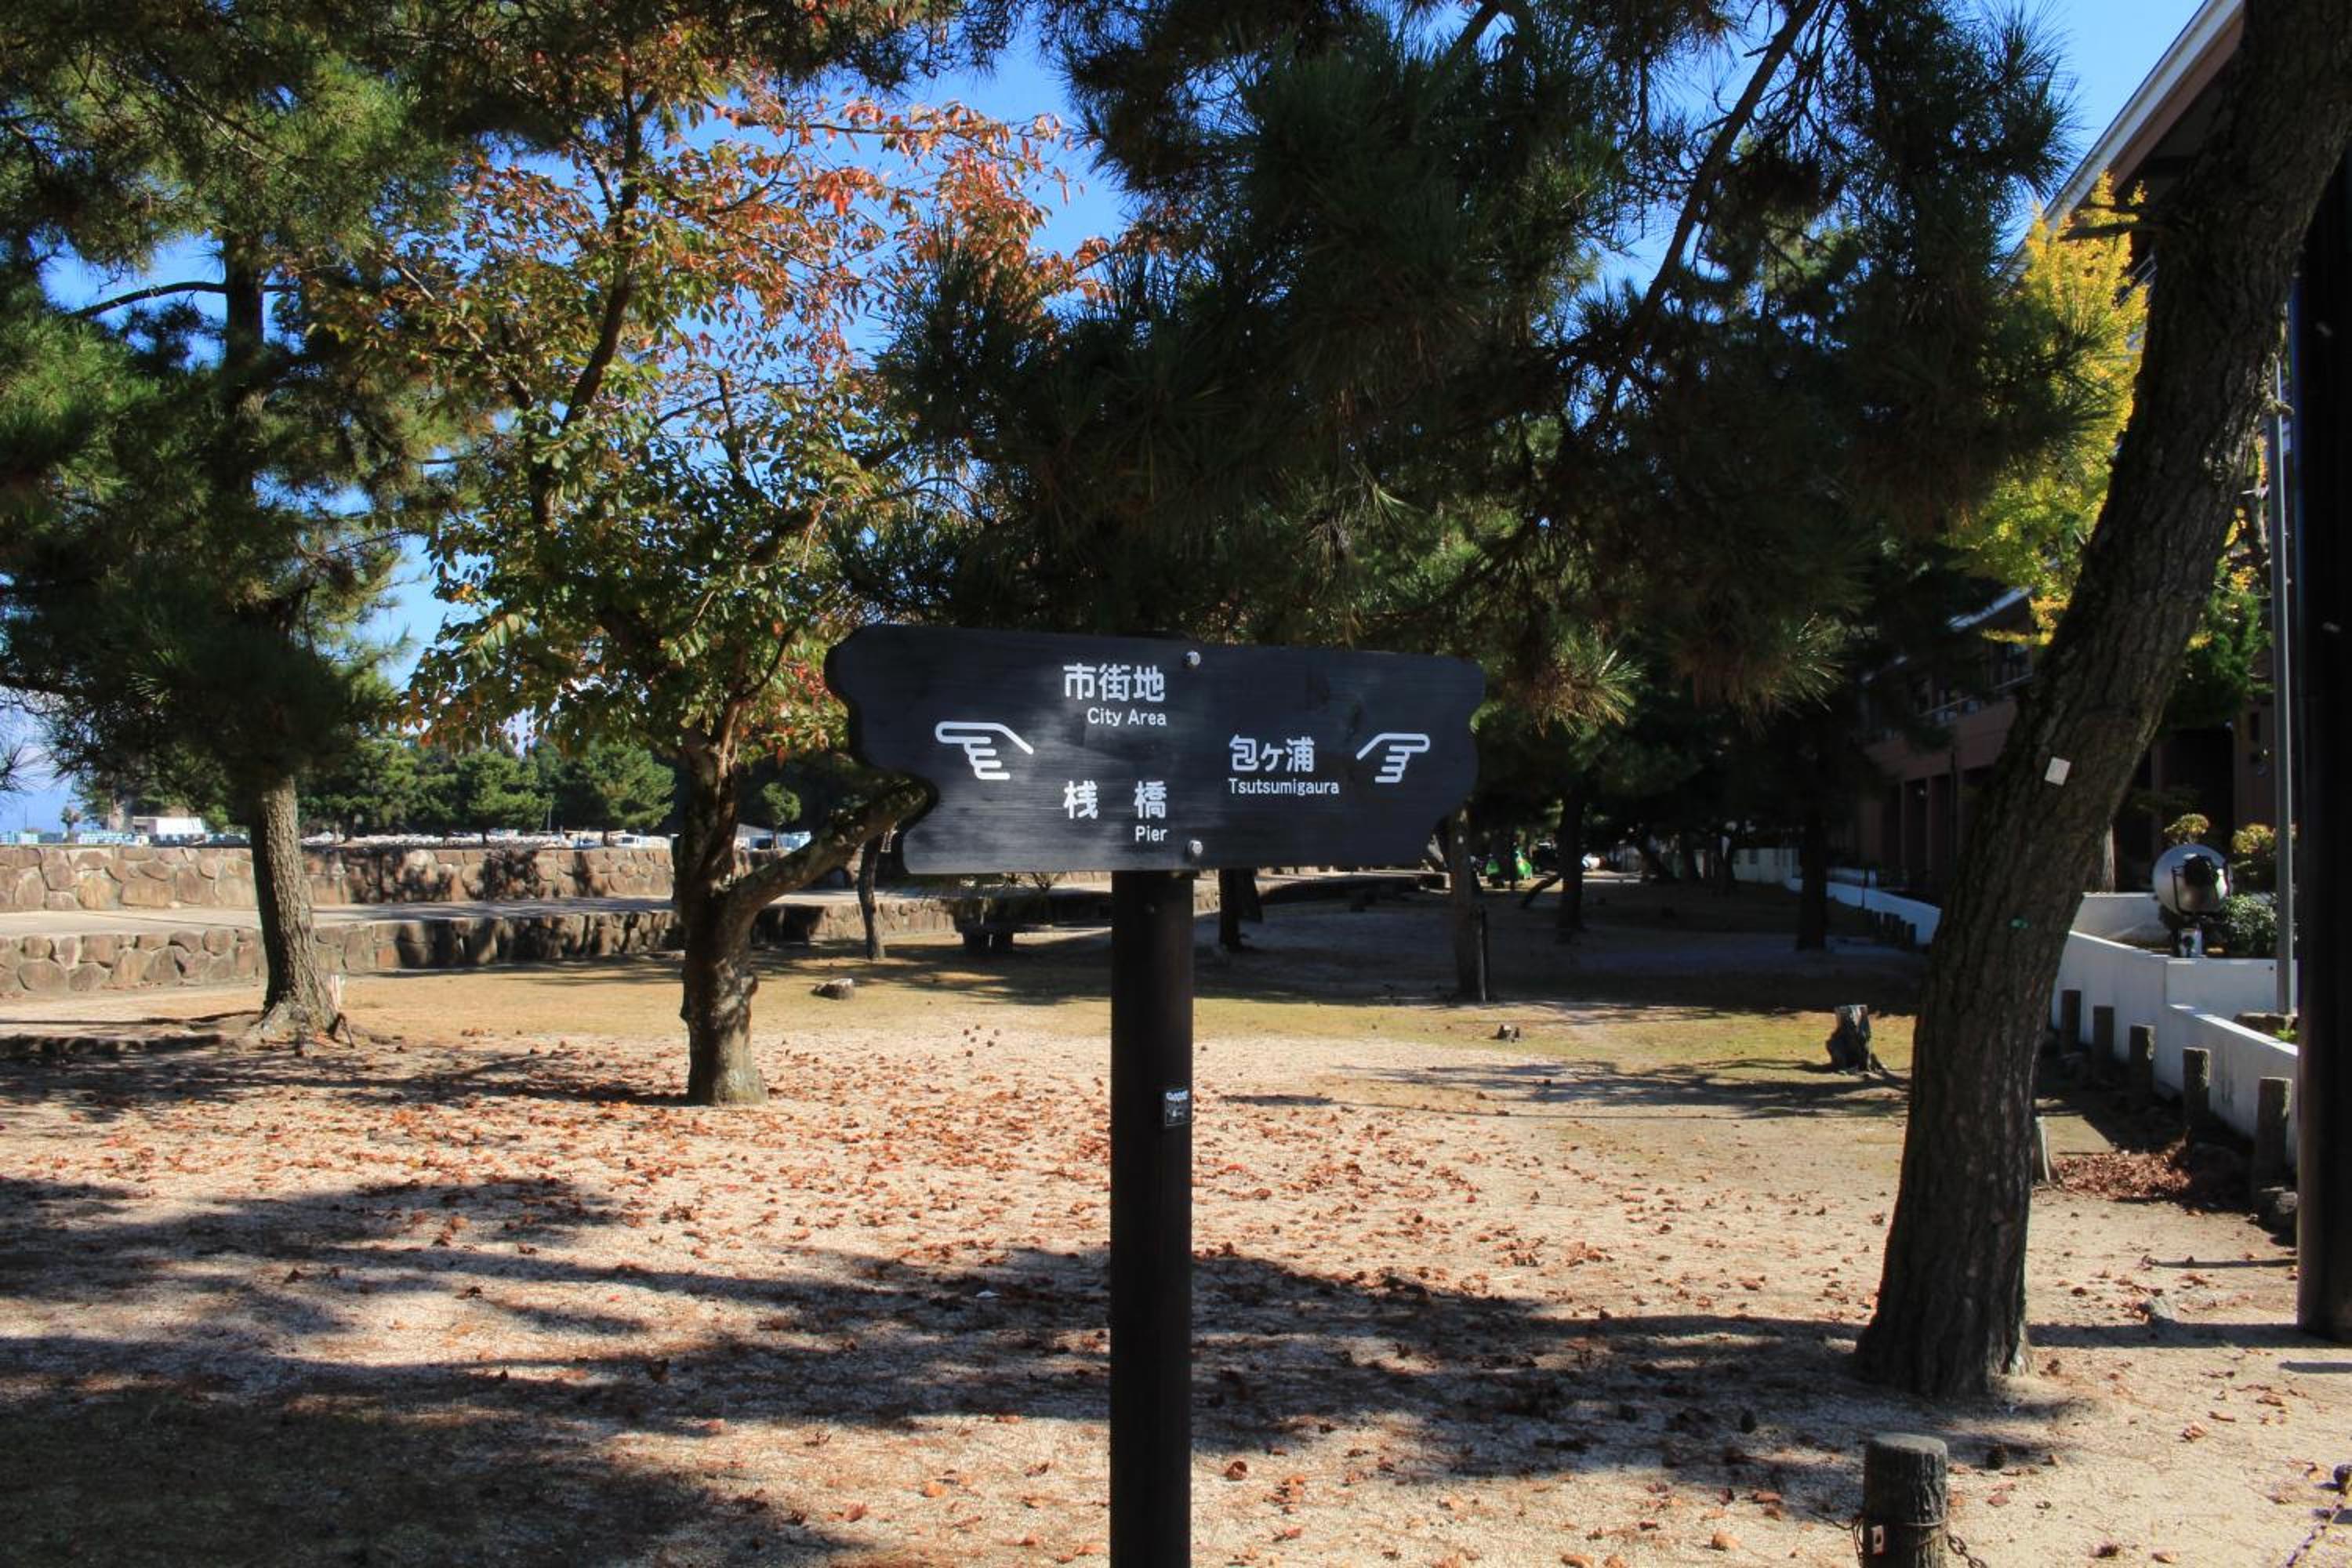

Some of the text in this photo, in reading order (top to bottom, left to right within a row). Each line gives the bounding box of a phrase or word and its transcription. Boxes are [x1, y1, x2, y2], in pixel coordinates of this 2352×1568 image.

[1063, 662, 1166, 702] 市街地
[1087, 707, 1167, 727] City Area
[1228, 777, 1341, 797] Tsutsumigaura
[1134, 825, 1168, 842] Pier
